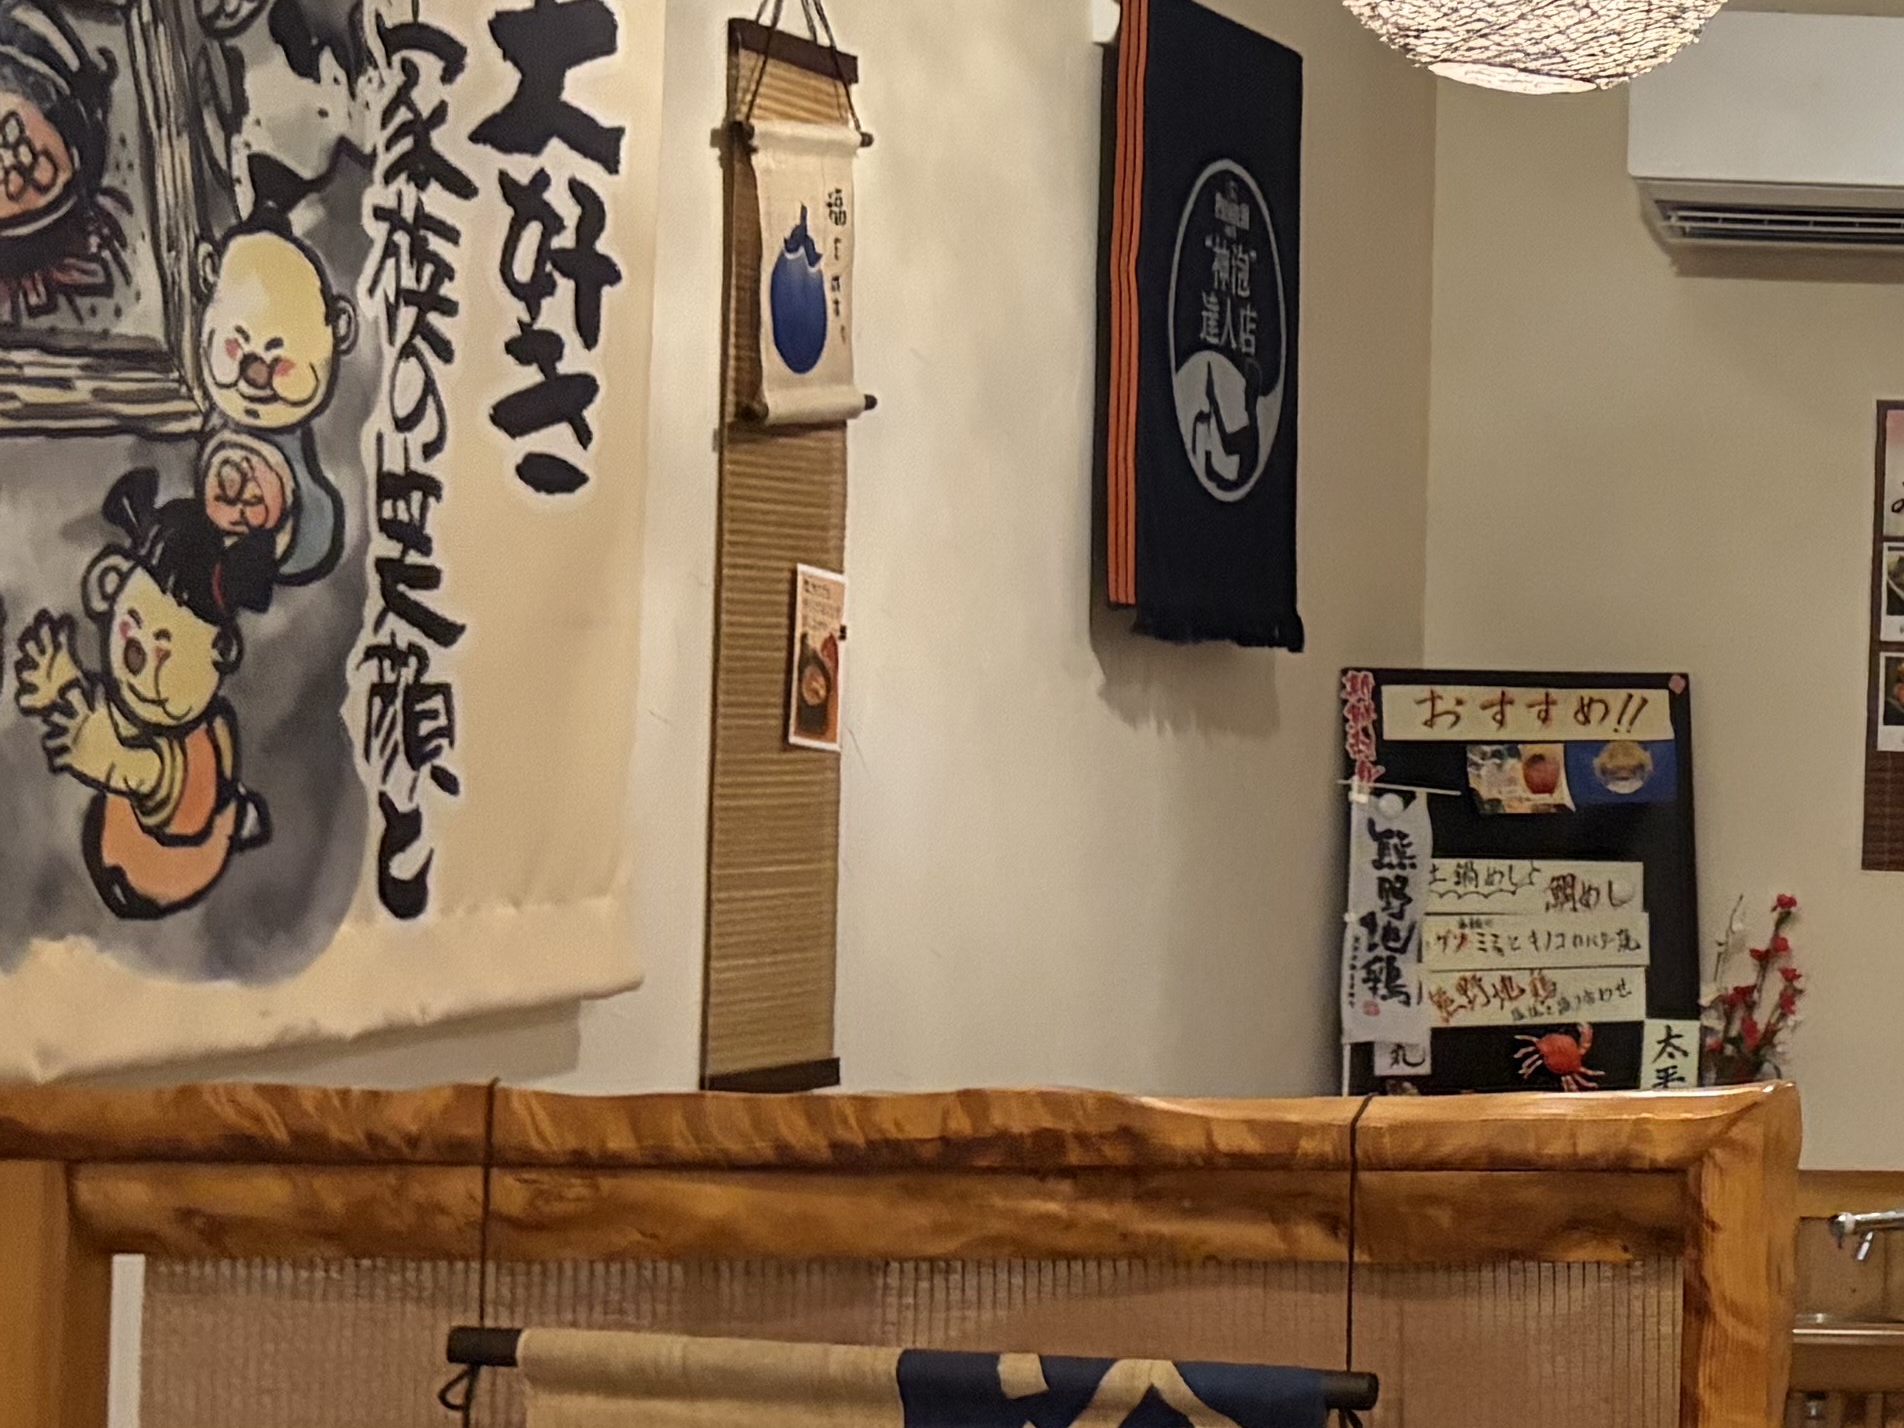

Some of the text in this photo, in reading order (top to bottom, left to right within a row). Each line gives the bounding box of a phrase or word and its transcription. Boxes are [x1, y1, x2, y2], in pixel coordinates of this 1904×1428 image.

[1414, 689, 1648, 733] おすすめ!!
[1359, 817, 1417, 1006] 熊野地鶏
